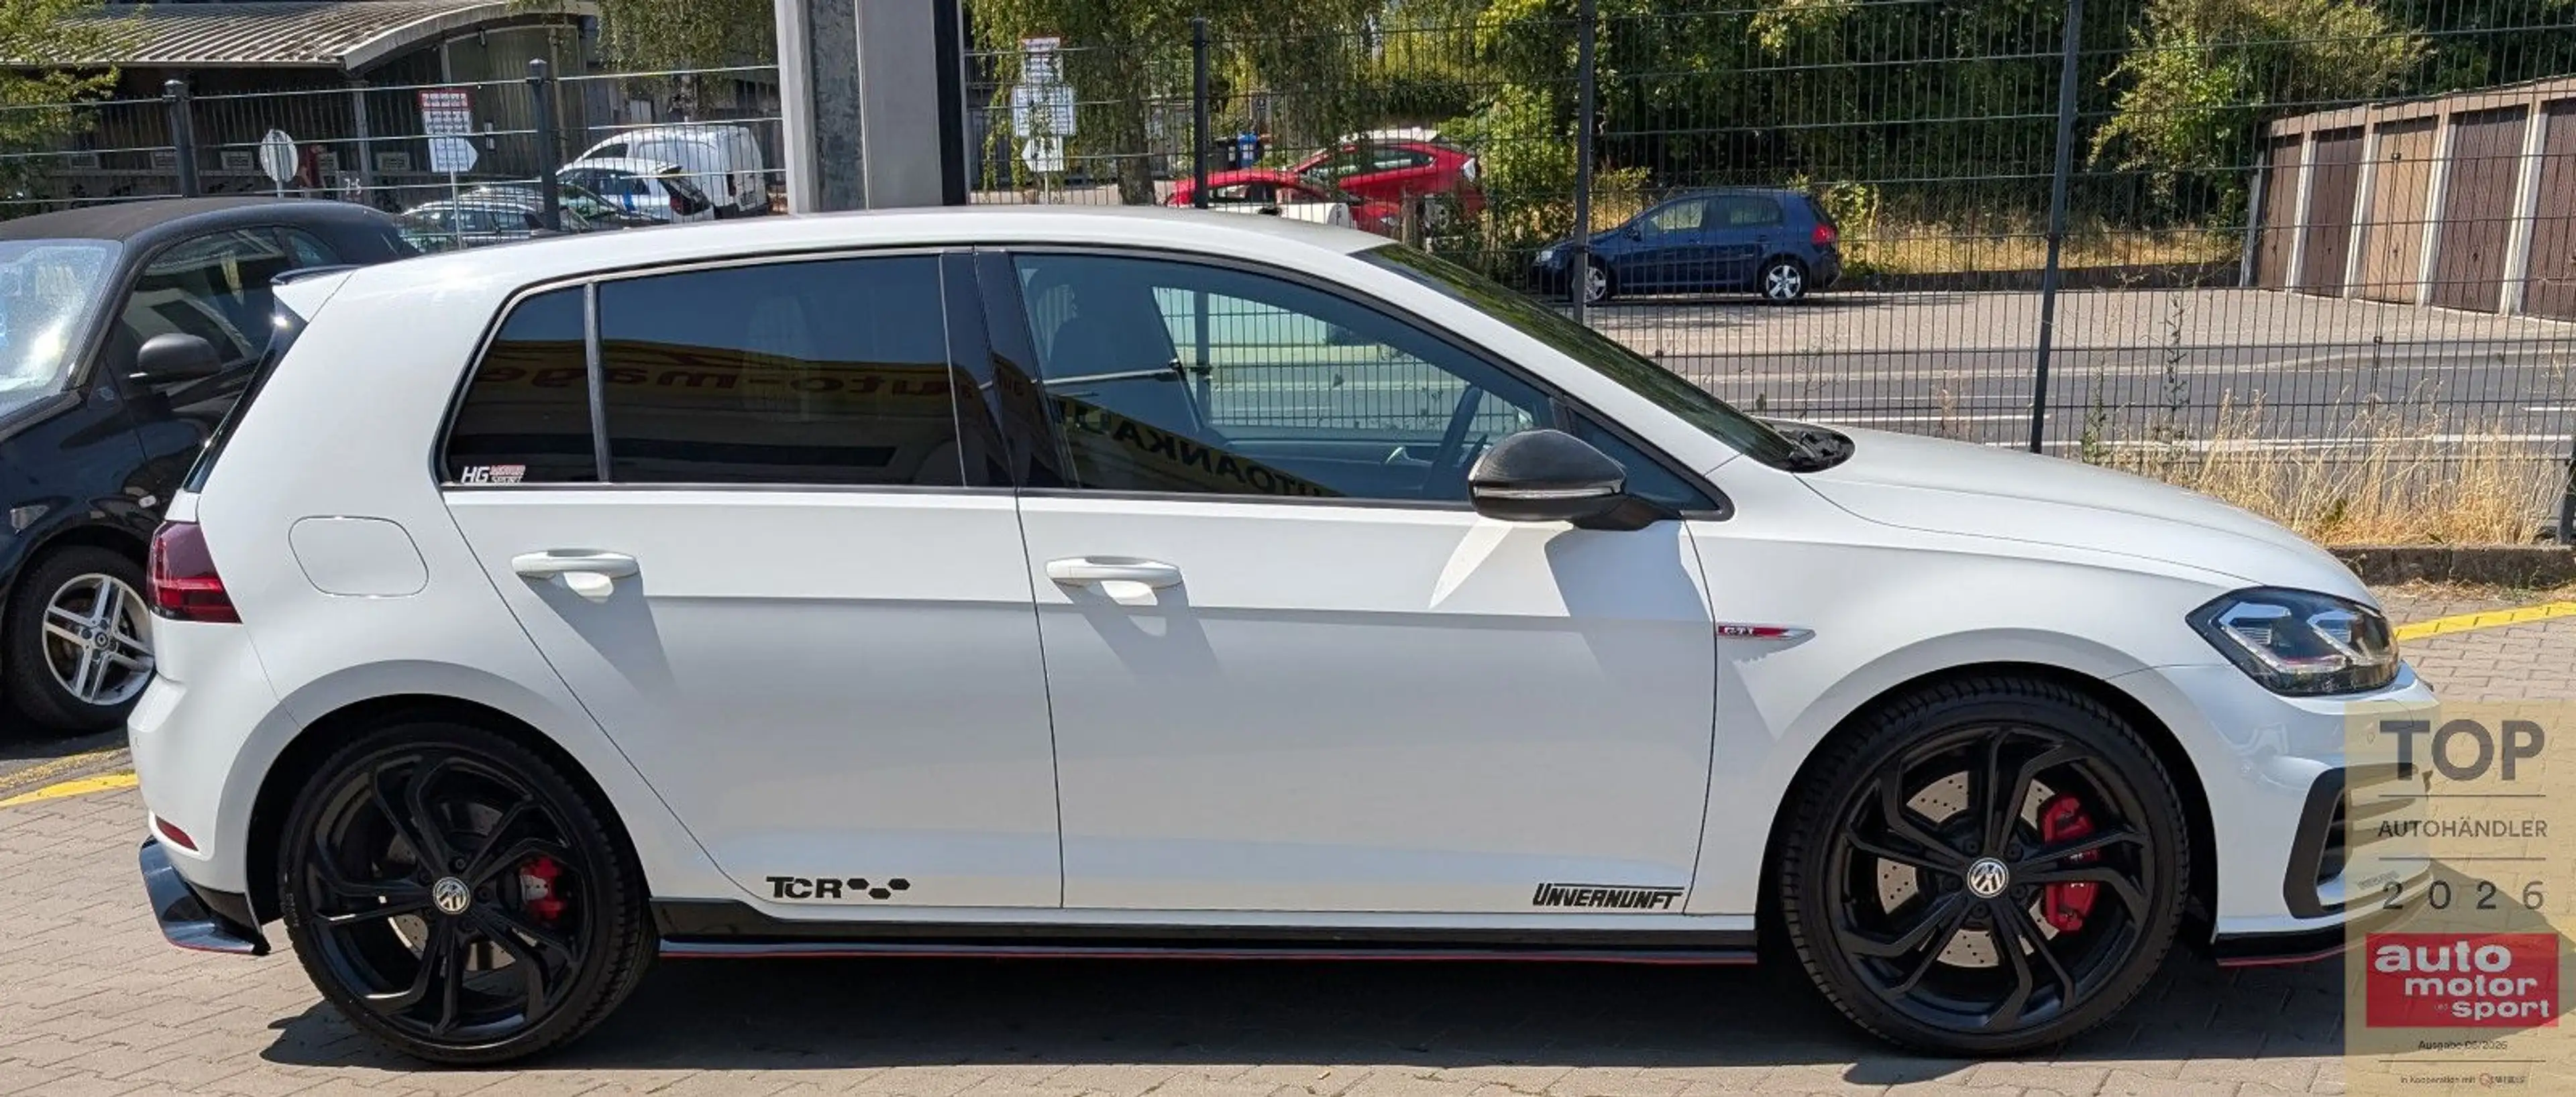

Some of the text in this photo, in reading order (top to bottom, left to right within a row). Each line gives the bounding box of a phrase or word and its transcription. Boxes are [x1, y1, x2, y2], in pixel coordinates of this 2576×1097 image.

[461, 466, 490, 483] HG
[766, 876, 843, 899] TCR
[1532, 882, 1684, 909] UNVERNUNFT
